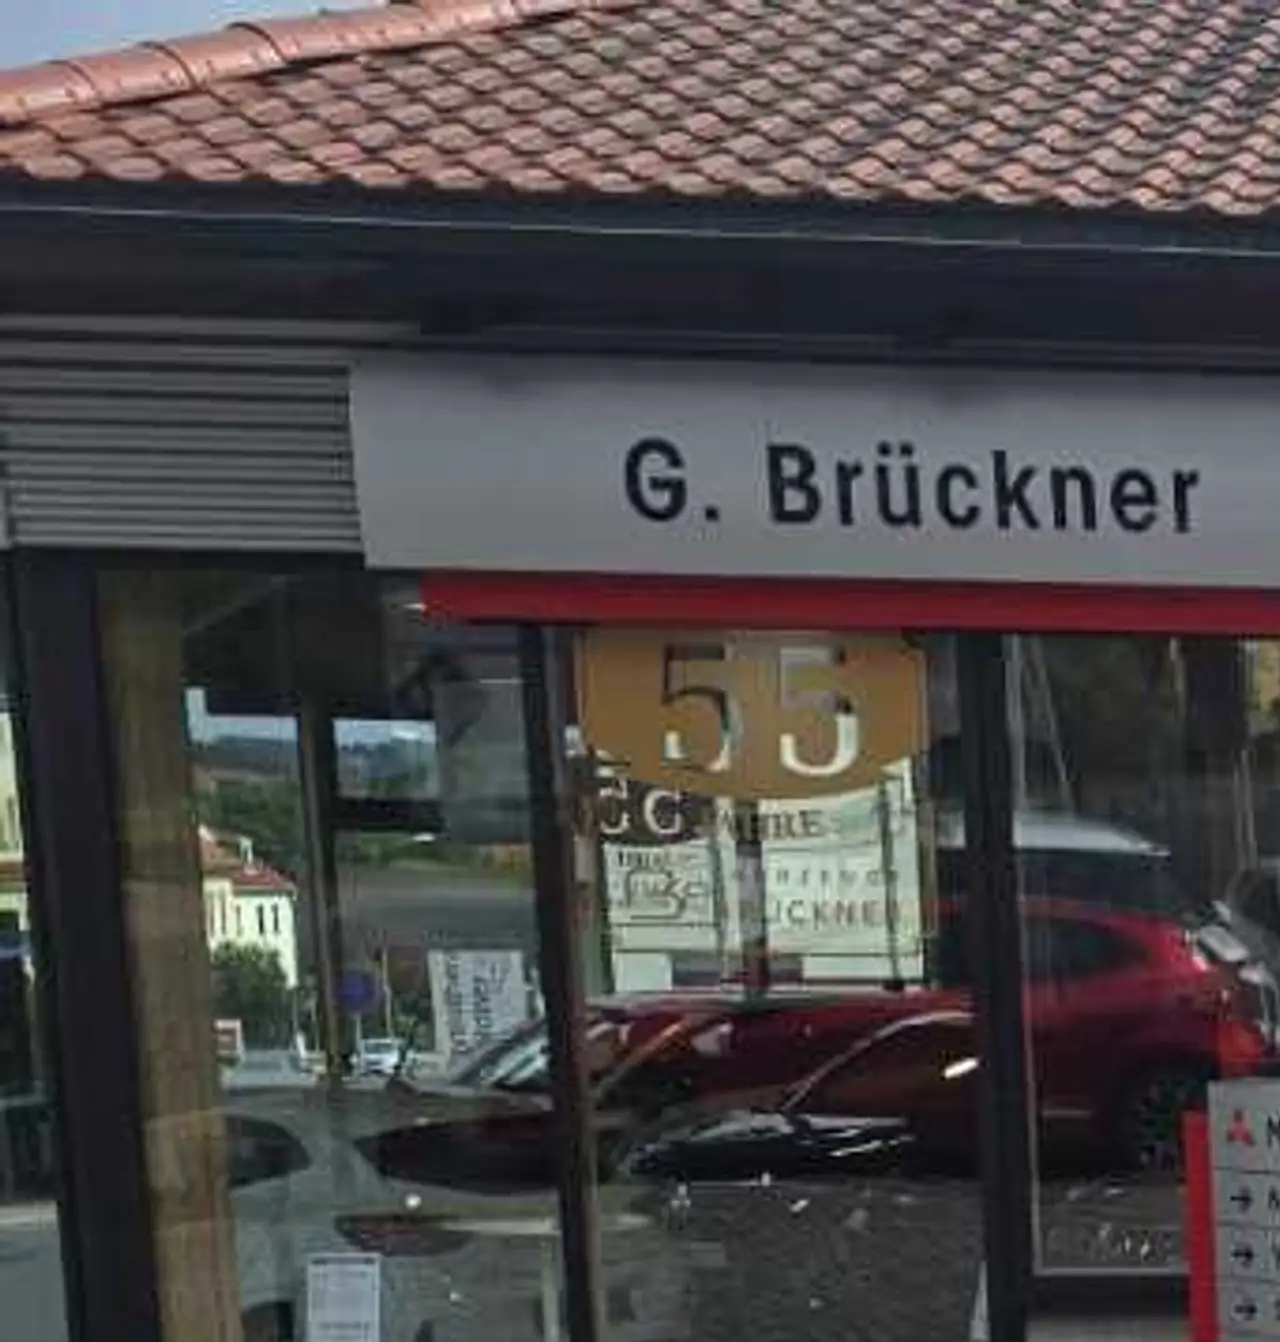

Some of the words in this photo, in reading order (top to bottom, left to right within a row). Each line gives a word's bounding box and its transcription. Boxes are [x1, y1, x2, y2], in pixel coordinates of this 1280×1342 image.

[625, 438, 720, 523] G.
[765, 442, 1199, 534] Brückner
[661, 643, 859, 778] 55
